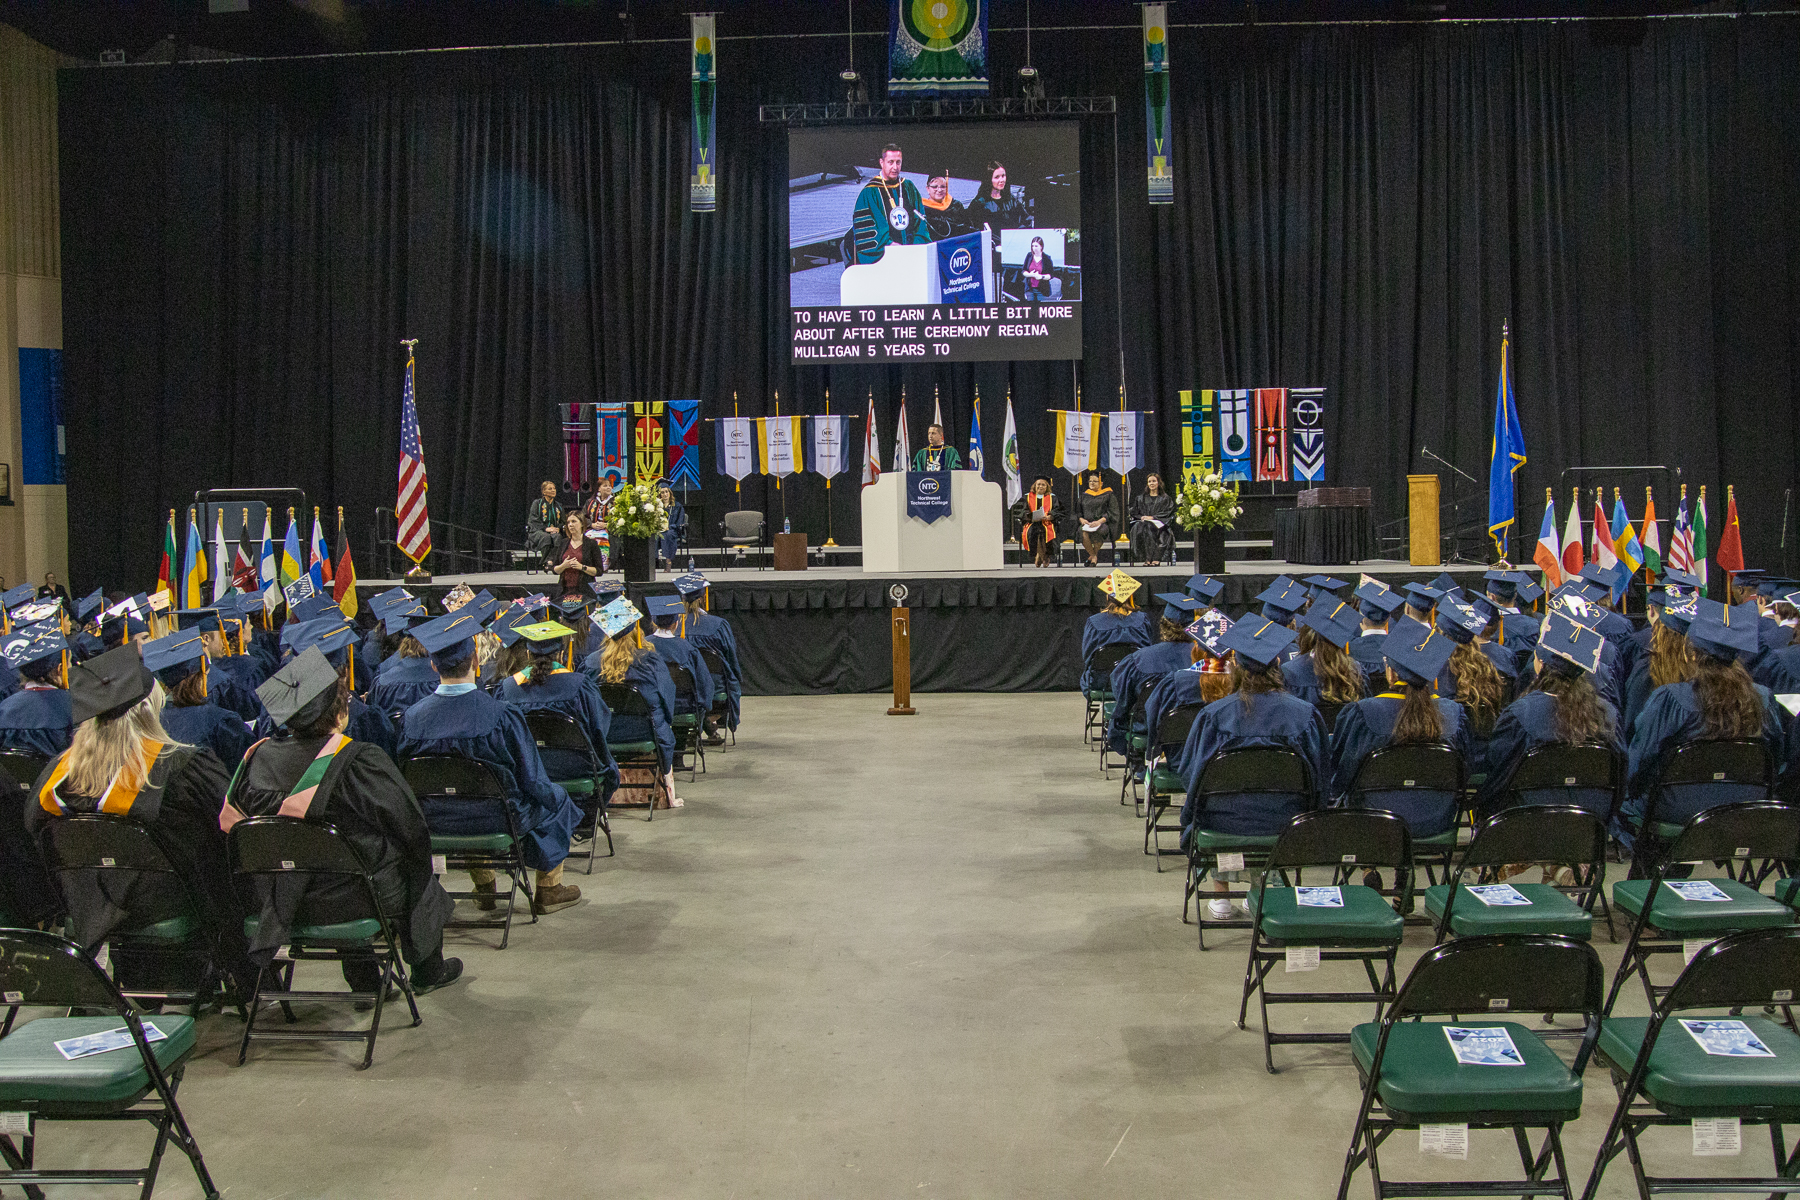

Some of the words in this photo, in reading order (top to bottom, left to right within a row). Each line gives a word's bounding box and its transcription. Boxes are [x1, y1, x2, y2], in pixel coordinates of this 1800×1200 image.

[953, 256, 969, 268] NTC
[949, 275, 973, 286] Northwest
[943, 285, 963, 295] Technical
[963, 281, 981, 291] College
[794, 311, 811, 323] TO
[818, 310, 852, 323] HAVE
[858, 309, 876, 322] TO
[884, 309, 925, 321] LEARN
[931, 308, 942, 321] A
[949, 307, 999, 320] LITTLE
[1006, 307, 1032, 319] BIT
[1038, 306, 1073, 319] MORE
[794, 328, 835, 341] ABOUT
[842, 327, 885, 340] AFTER
[891, 327, 917, 339] THE
[924, 325, 991, 338] CEREMONY
[998, 324, 1049, 337] REGINA
[794, 345, 860, 358] MULLIGAN
[867, 344, 877, 357] 5
[883, 344, 926, 357] YEARS
[932, 343, 950, 356] TO
